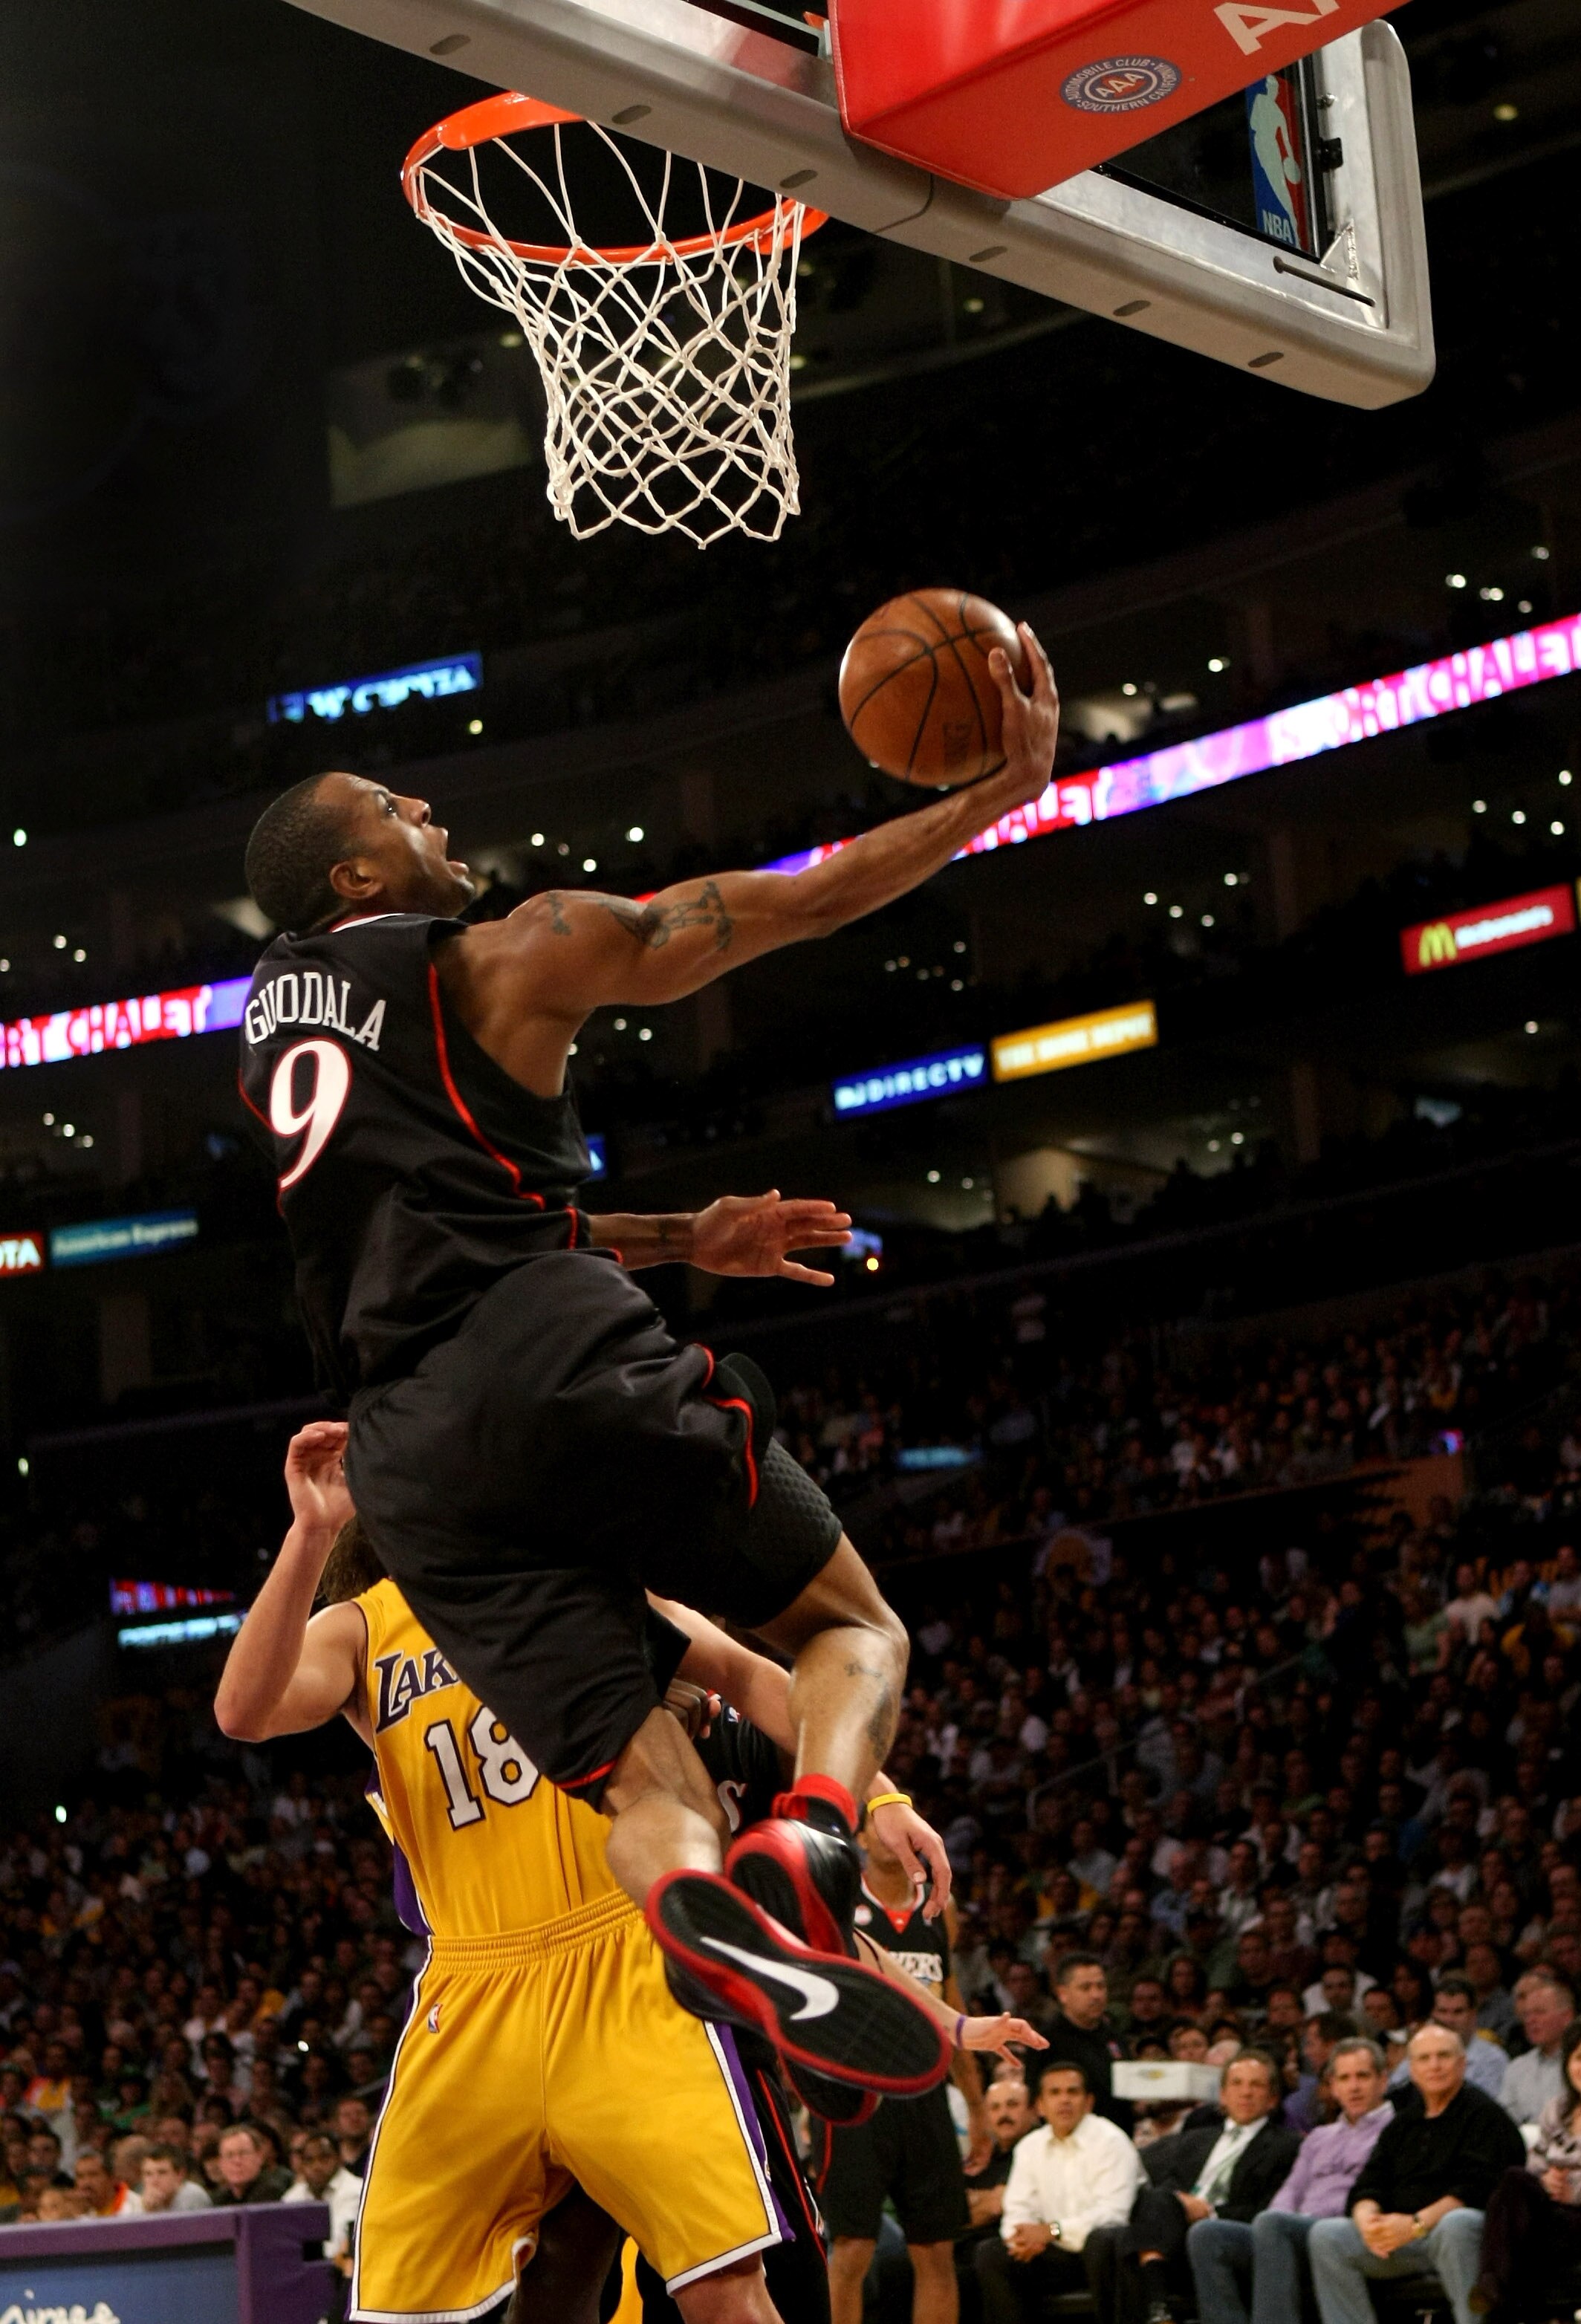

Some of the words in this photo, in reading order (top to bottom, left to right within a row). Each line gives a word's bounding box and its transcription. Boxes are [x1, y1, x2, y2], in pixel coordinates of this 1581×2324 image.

[1065, 60, 1113, 101] AUTOMOBILE
[1115, 57, 1152, 68] CLUB
[1095, 72, 1145, 98] AAA
[1077, 98, 1150, 112] SOUTHERN
[1263, 209, 1294, 245] NBA
[866, 1052, 985, 1104] DIRECTV
[270, 1036, 354, 1192] 9
[423, 1704, 544, 1832] 18
